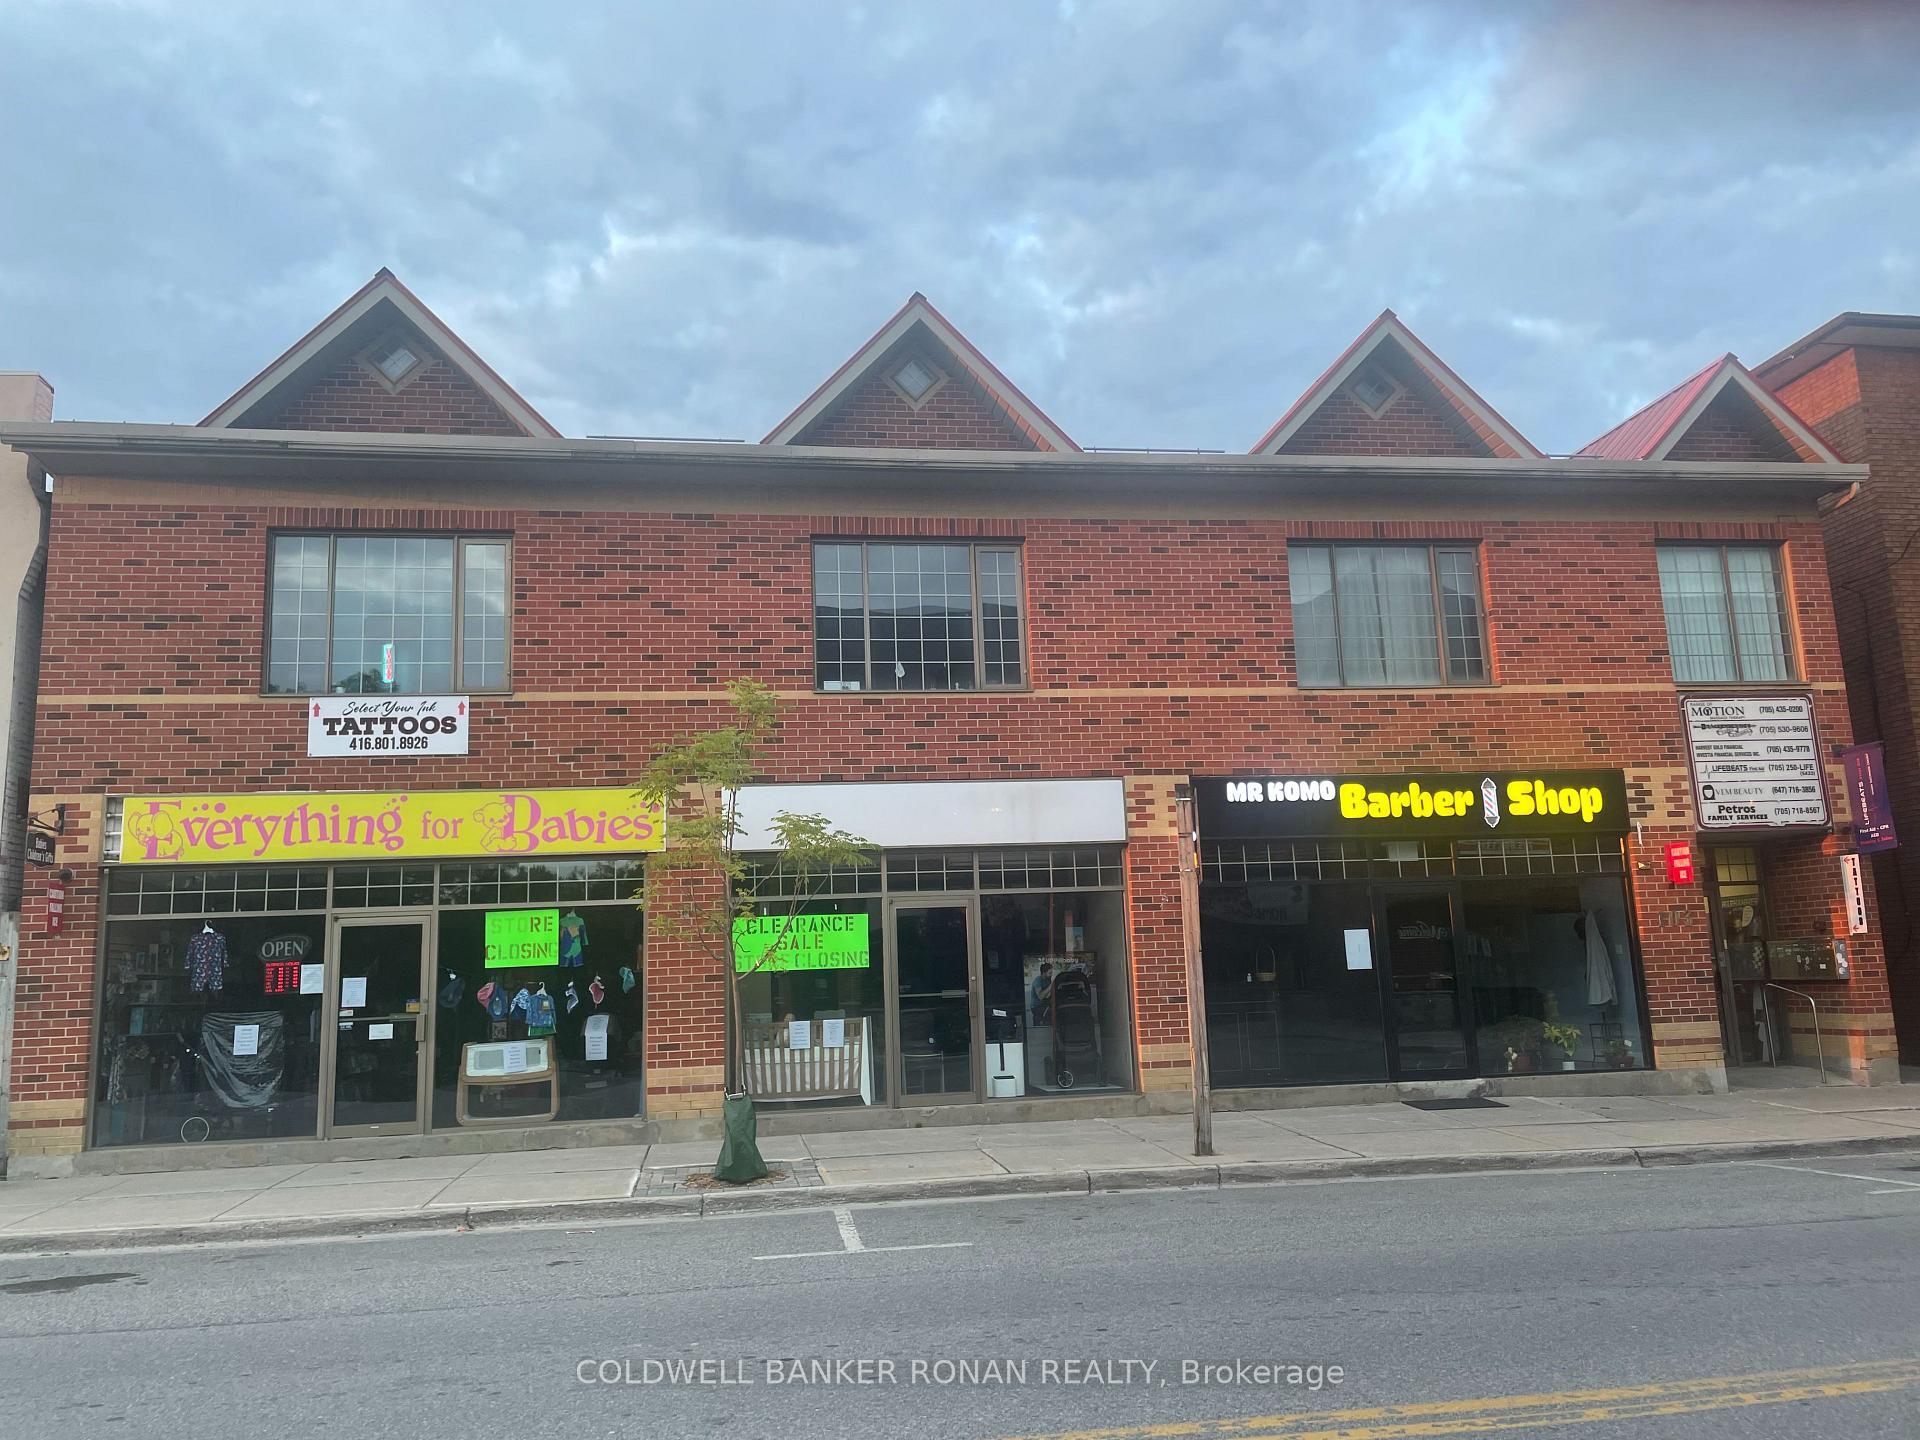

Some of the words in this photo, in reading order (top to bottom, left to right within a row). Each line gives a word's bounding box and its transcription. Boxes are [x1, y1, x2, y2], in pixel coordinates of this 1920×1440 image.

[342, 701, 380, 716] Select
[382, 700, 413, 717] Your
[417, 700, 437, 716] Ink
[1691, 706, 1745, 716] MOTION
[1759, 706, 1775, 714] (705)
[322, 716, 457, 736] TATTOOS
[1759, 726, 1776, 735] (705)
[349, 736, 428, 750] 416.801.8926
[1766, 745, 1782, 754] (705)
[1712, 764, 1748, 772] LIFEBEATS
[1768, 764, 1785, 772] (705)
[1772, 786, 1788, 795] (647)
[1226, 781, 1264, 803] MR
[1267, 780, 1336, 802] KOMO
[1339, 782, 1475, 819] Barber
[1506, 779, 1603, 823] Shop
[1718, 804, 1756, 814] Petros
[1774, 807, 1791, 816] (705)
[1736, 813, 1768, 821] SERVICES
[140, 799, 405, 860] Everything
[421, 810, 464, 840] for
[493, 794, 654, 853] Babies
[1851, 857, 1864, 926] TATTOOS
[491, 916, 553, 934] STORE
[746, 916, 854, 935] CLEARANCE
[261, 940, 305, 958] OPEN
[778, 934, 823, 951] SALE
[484, 942, 558, 961] CLOSING
[794, 951, 868, 968] CLOSING
